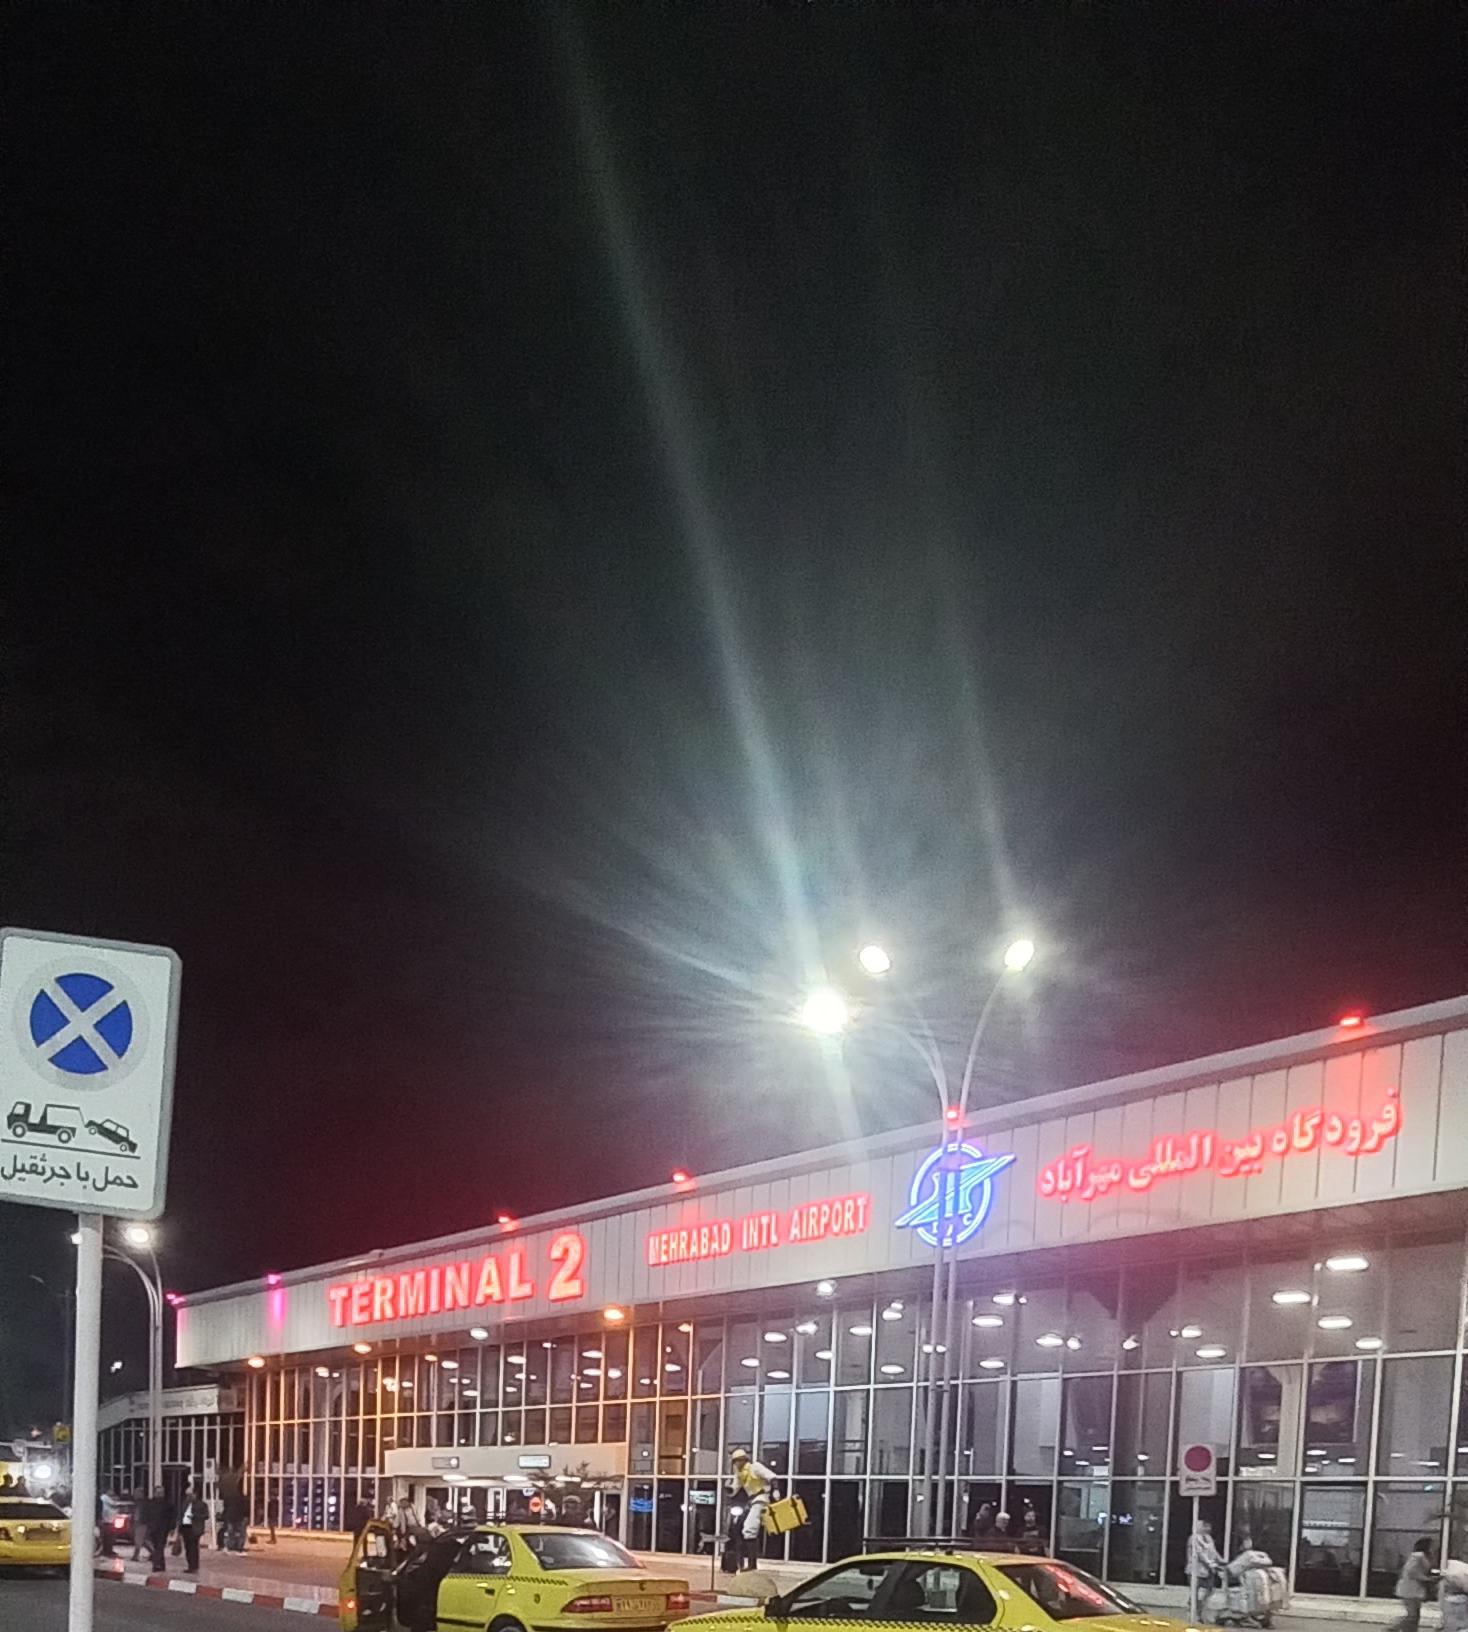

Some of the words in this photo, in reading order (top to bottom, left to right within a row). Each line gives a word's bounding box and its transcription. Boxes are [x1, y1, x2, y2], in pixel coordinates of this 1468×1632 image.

[1271, 1087, 1401, 1152] فرودگاه
[0, 1152, 72, 1186] جرثقیل
[76, 1161, 90, 1189] با
[92, 1166, 139, 1192] حمل
[1039, 1148, 1123, 1201] مهرآباد
[1126, 1133, 1213, 1190] المللی
[1219, 1134, 1263, 1176] بین
[648, 1222, 732, 1266] MEHRABAD
[741, 1213, 778, 1250] INTL
[789, 1195, 869, 1242] AIRPORT
[328, 1251, 534, 1327] TERMINAL
[548, 1233, 585, 1300] 2
